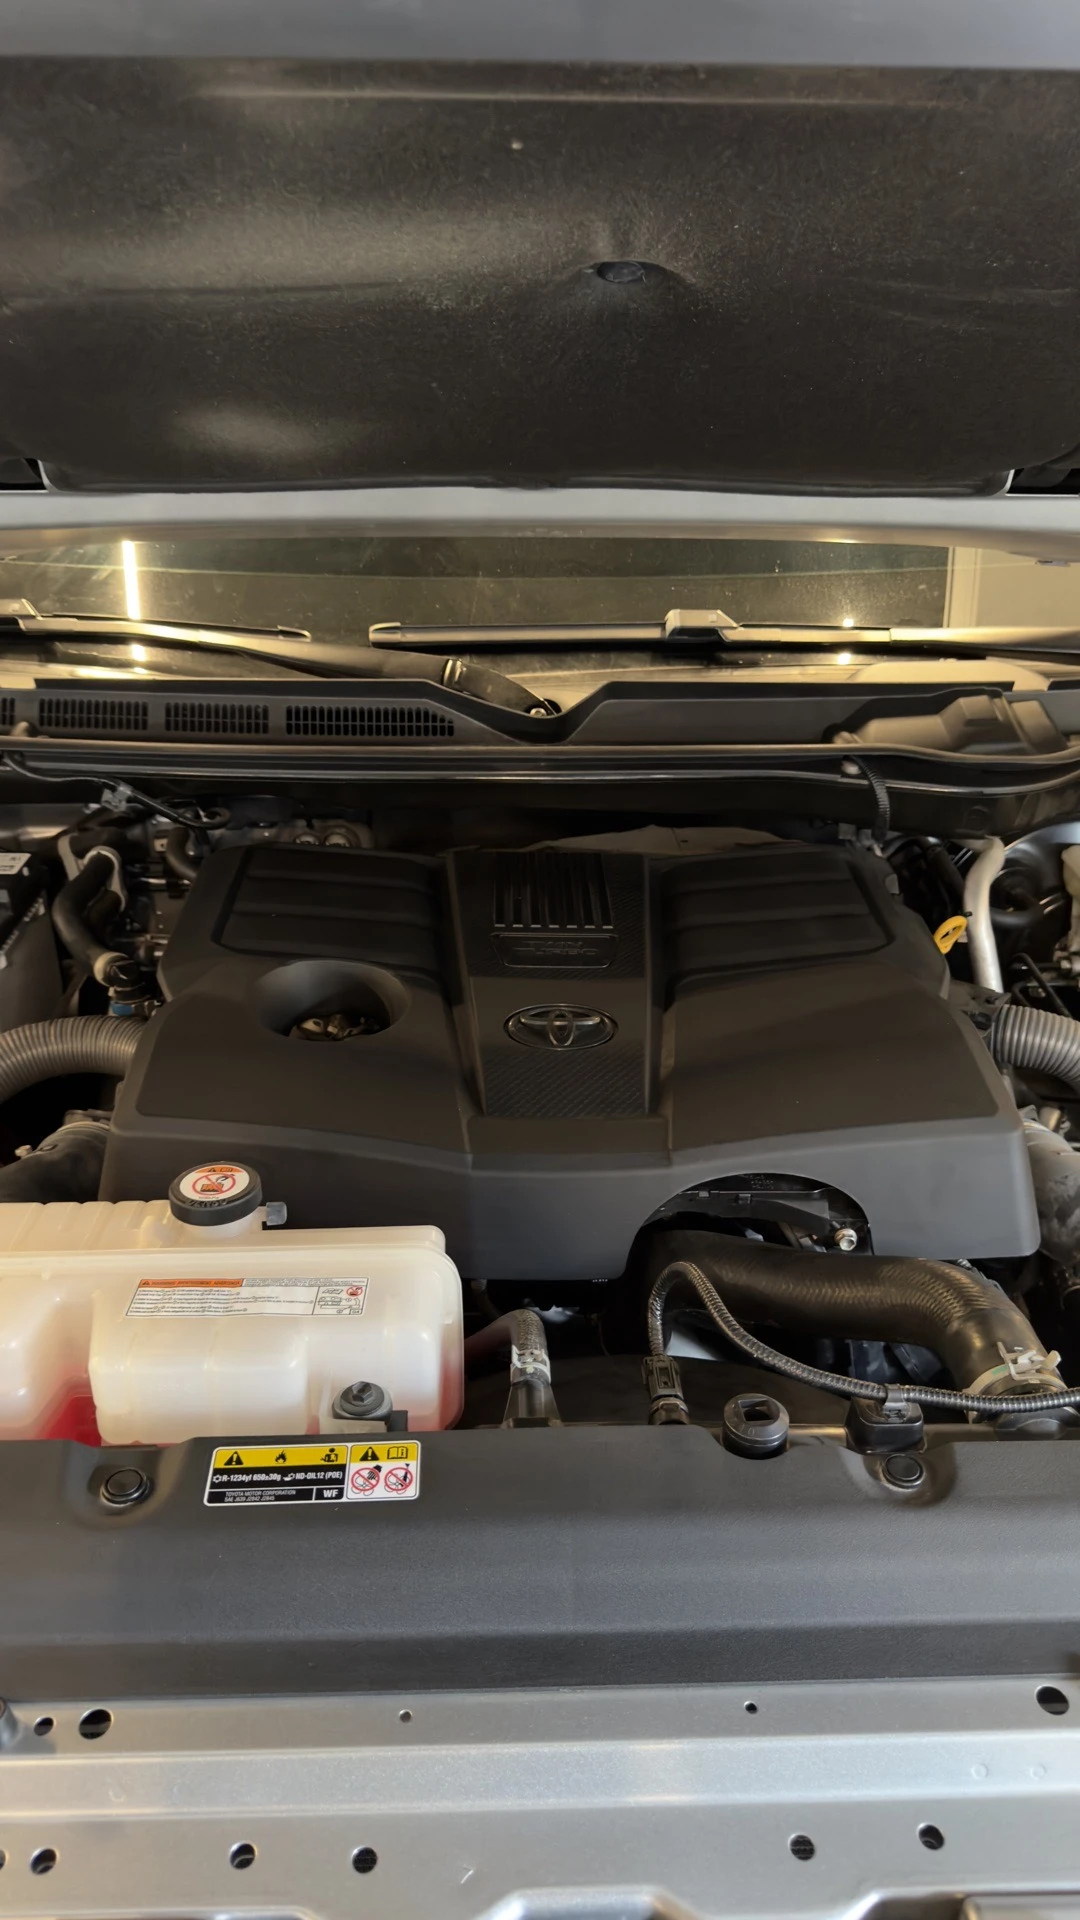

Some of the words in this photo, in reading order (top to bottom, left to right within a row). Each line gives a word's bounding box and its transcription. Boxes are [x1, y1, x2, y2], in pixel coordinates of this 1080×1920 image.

[222, 1474, 252, 1483] R-1234yf
[253, 1473, 281, 1482] 650±30g
[325, 1471, 343, 1480] (POE)
[323, 1489, 339, 1498] WF
